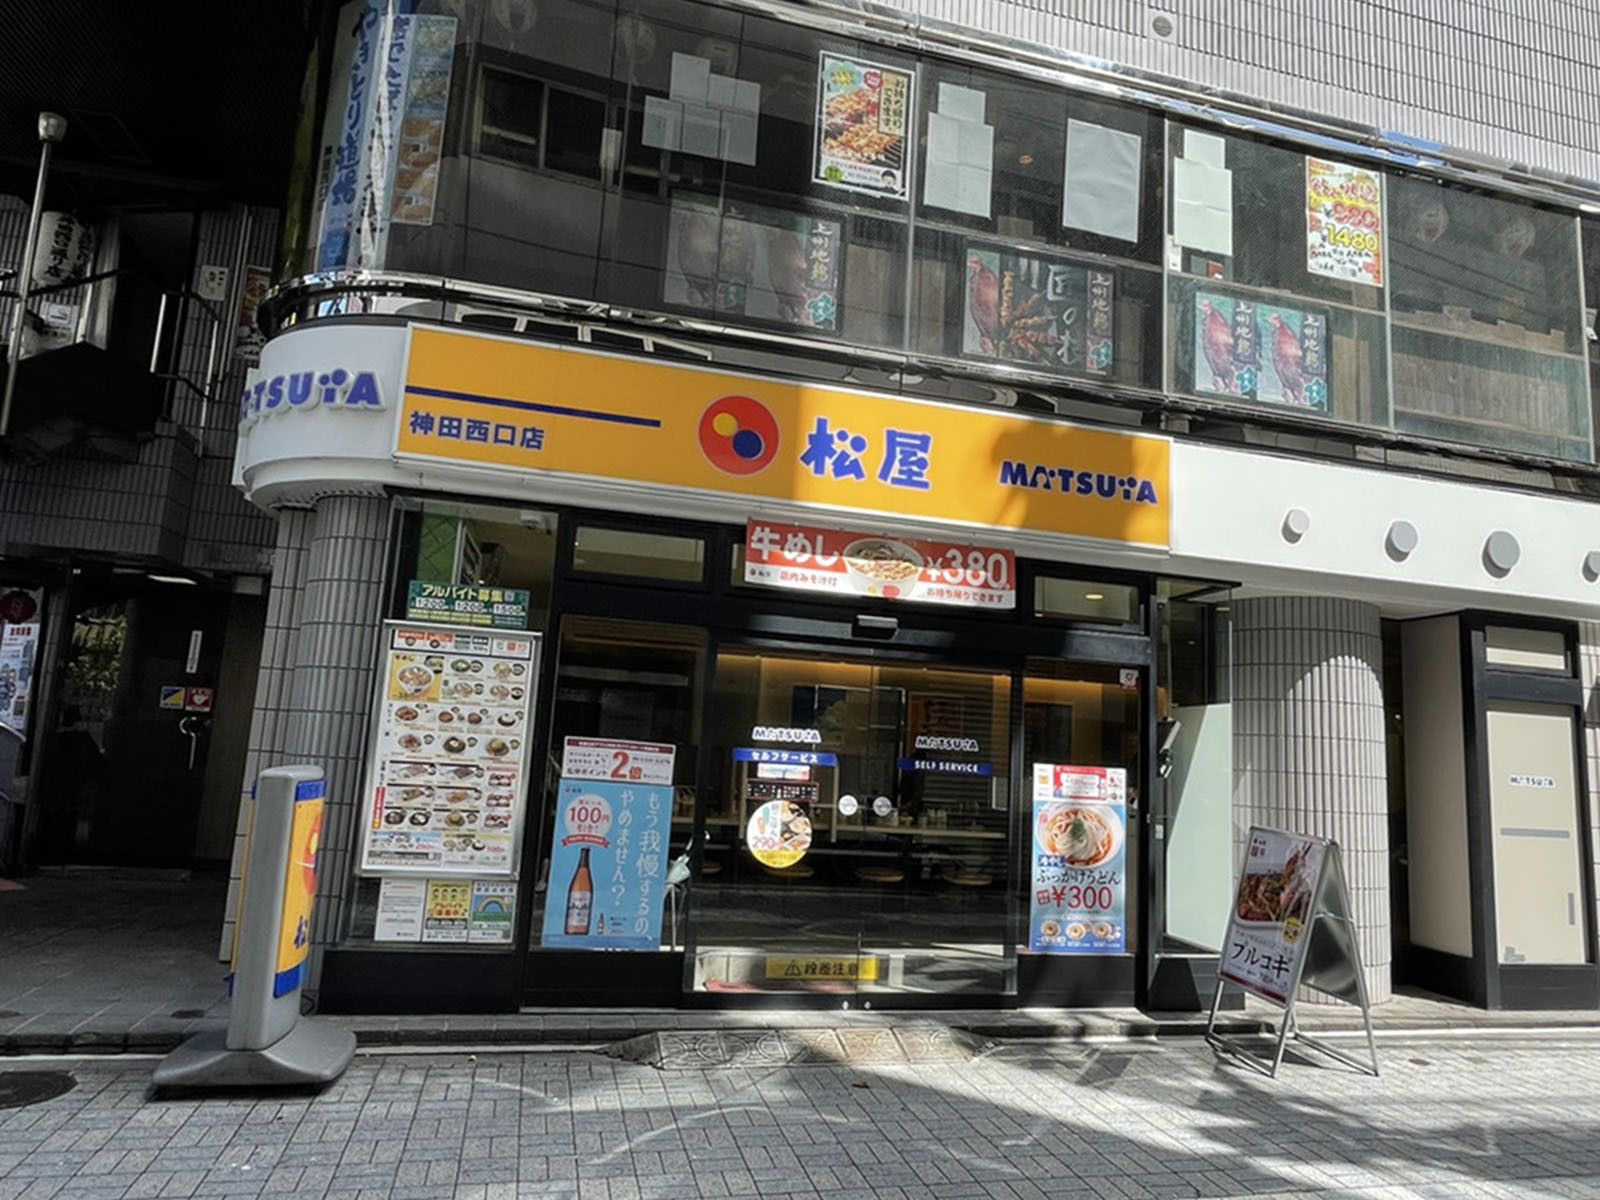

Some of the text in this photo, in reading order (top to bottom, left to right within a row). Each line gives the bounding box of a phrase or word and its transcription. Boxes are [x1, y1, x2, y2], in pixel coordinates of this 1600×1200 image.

[409, 411, 545, 450] 神田西口店
[799, 417, 932, 489] 松屋
[999, 460, 1158, 504] MATSUYA
[751, 526, 840, 567] 牛めし
[926, 547, 1008, 589] ¥380
[926, 587, 1004, 603] お持ち帰りできます
[753, 727, 821, 742] MATSUYA
[916, 736, 979, 752] MATSUYA
[751, 751, 819, 763] セルフサービス
[914, 760, 978, 773] SELF SERVICE
[635, 791, 662, 941] もう我慢するの、
[1036, 869, 1121, 886] ぶっかけうどん
[1052, 885, 1113, 910] ¥300
